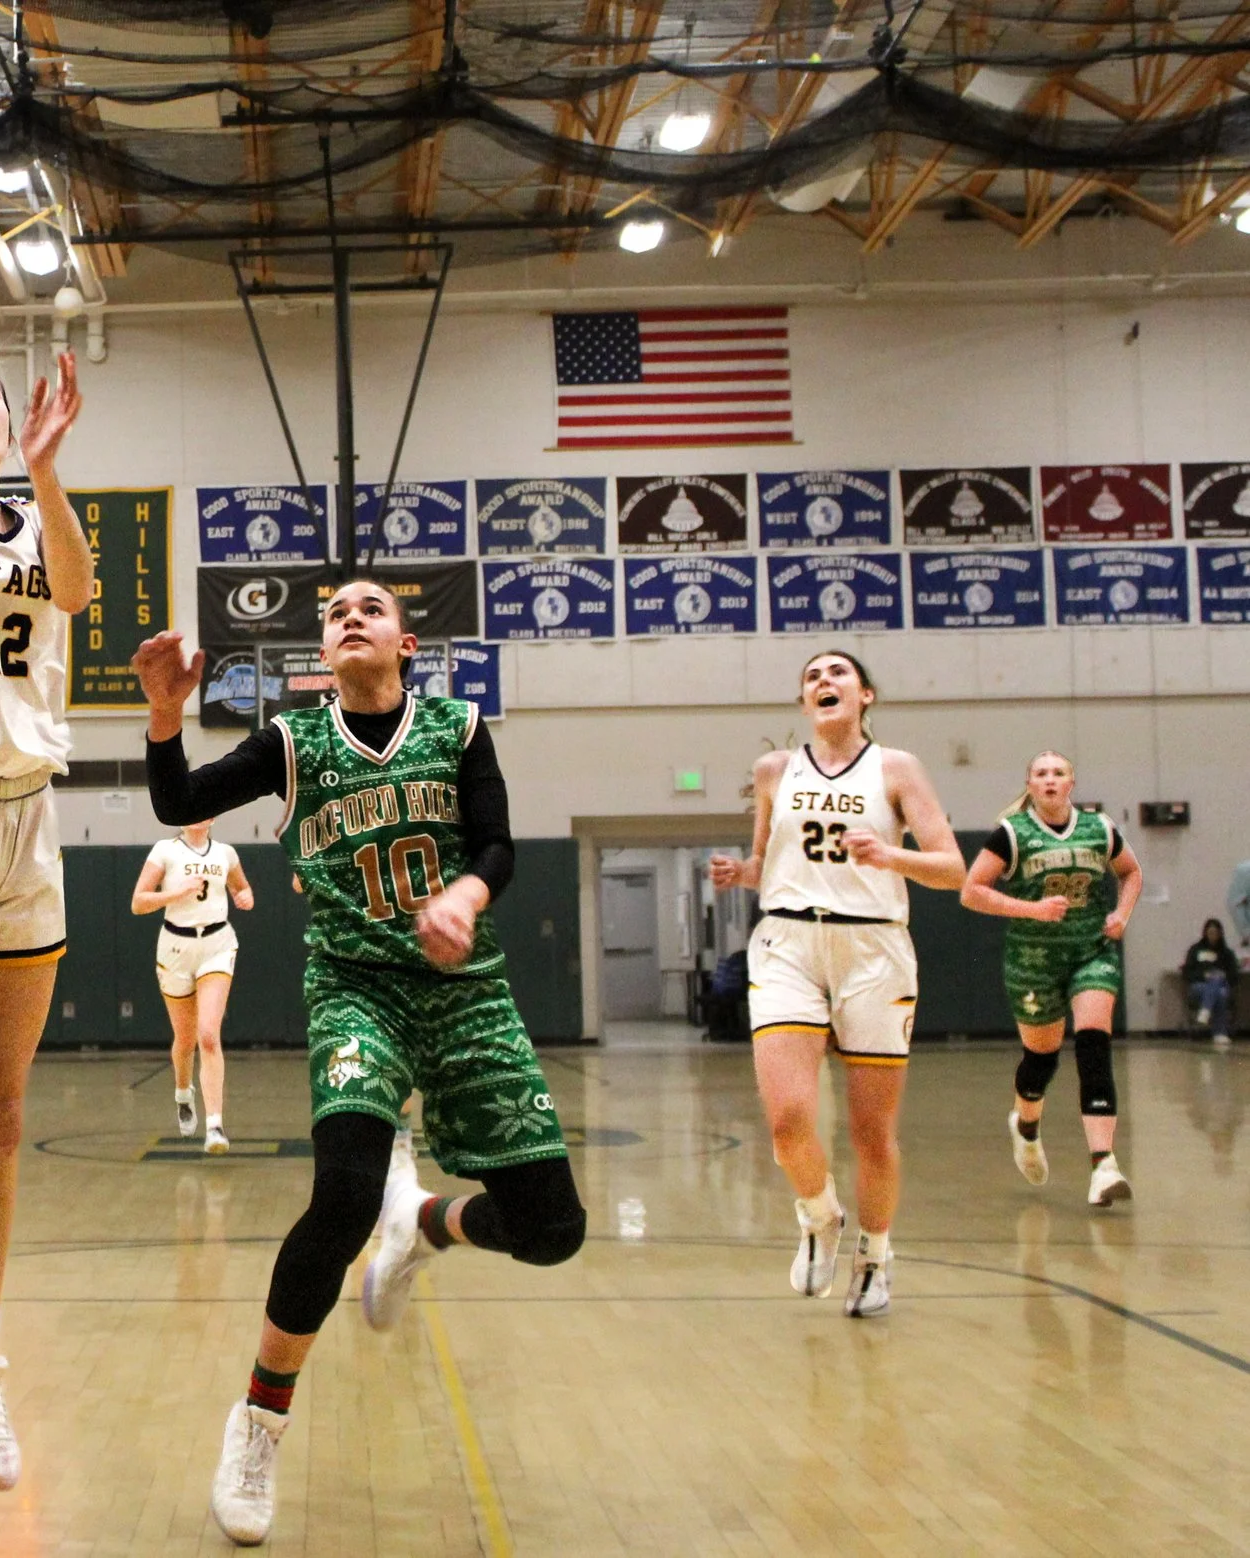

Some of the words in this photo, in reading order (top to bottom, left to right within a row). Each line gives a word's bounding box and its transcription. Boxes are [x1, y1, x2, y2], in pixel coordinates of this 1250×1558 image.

[763, 480, 790, 504] GOOD
[794, 472, 886, 501] SPORTSMANSHIP
[805, 484, 843, 495] AWARD
[245, 500, 281, 511] AWARD
[479, 494, 504, 523] GOOD
[505, 480, 605, 518] SPORTSMANSHIP
[519, 493, 564, 506] AWARD
[202, 497, 229, 519] GOOD
[766, 512, 798, 524] WEST
[492, 519, 526, 531] WEST
[207, 527, 235, 538] EAST
[136, 503, 150, 625] HILLS
[951, 554, 1030, 573] SPORTSMANSHIP
[630, 565, 658, 589] GOOD
[660, 559, 752, 588] SPORTSMANSHIP
[673, 571, 711, 583] AWARD
[773, 564, 802, 588] GOOD
[805, 556, 897, 585] SPORTSMANSHIP
[815, 569, 855, 581] AWARD
[956, 568, 1000, 582] AWARD
[1098, 564, 1143, 577] AWARD
[488, 570, 516, 594] GOOD
[517, 562, 612, 592] SPORTSMANSHIP
[531, 575, 569, 587] AWARD
[918, 592, 948, 605] CLASS
[951, 592, 960, 605] A
[1065, 587, 1102, 601] EAST
[494, 603, 524, 615] EAST
[578, 602, 606, 614] 2012
[634, 598, 665, 610] EAST
[779, 596, 809, 609] EAST
[792, 792, 864, 814] STAGS
[300, 784, 400, 858] OXFORD
[803, 821, 848, 863] 23
[184, 863, 223, 876] STAGS
[353, 833, 445, 922] 10
[197, 880, 209, 901] 3
